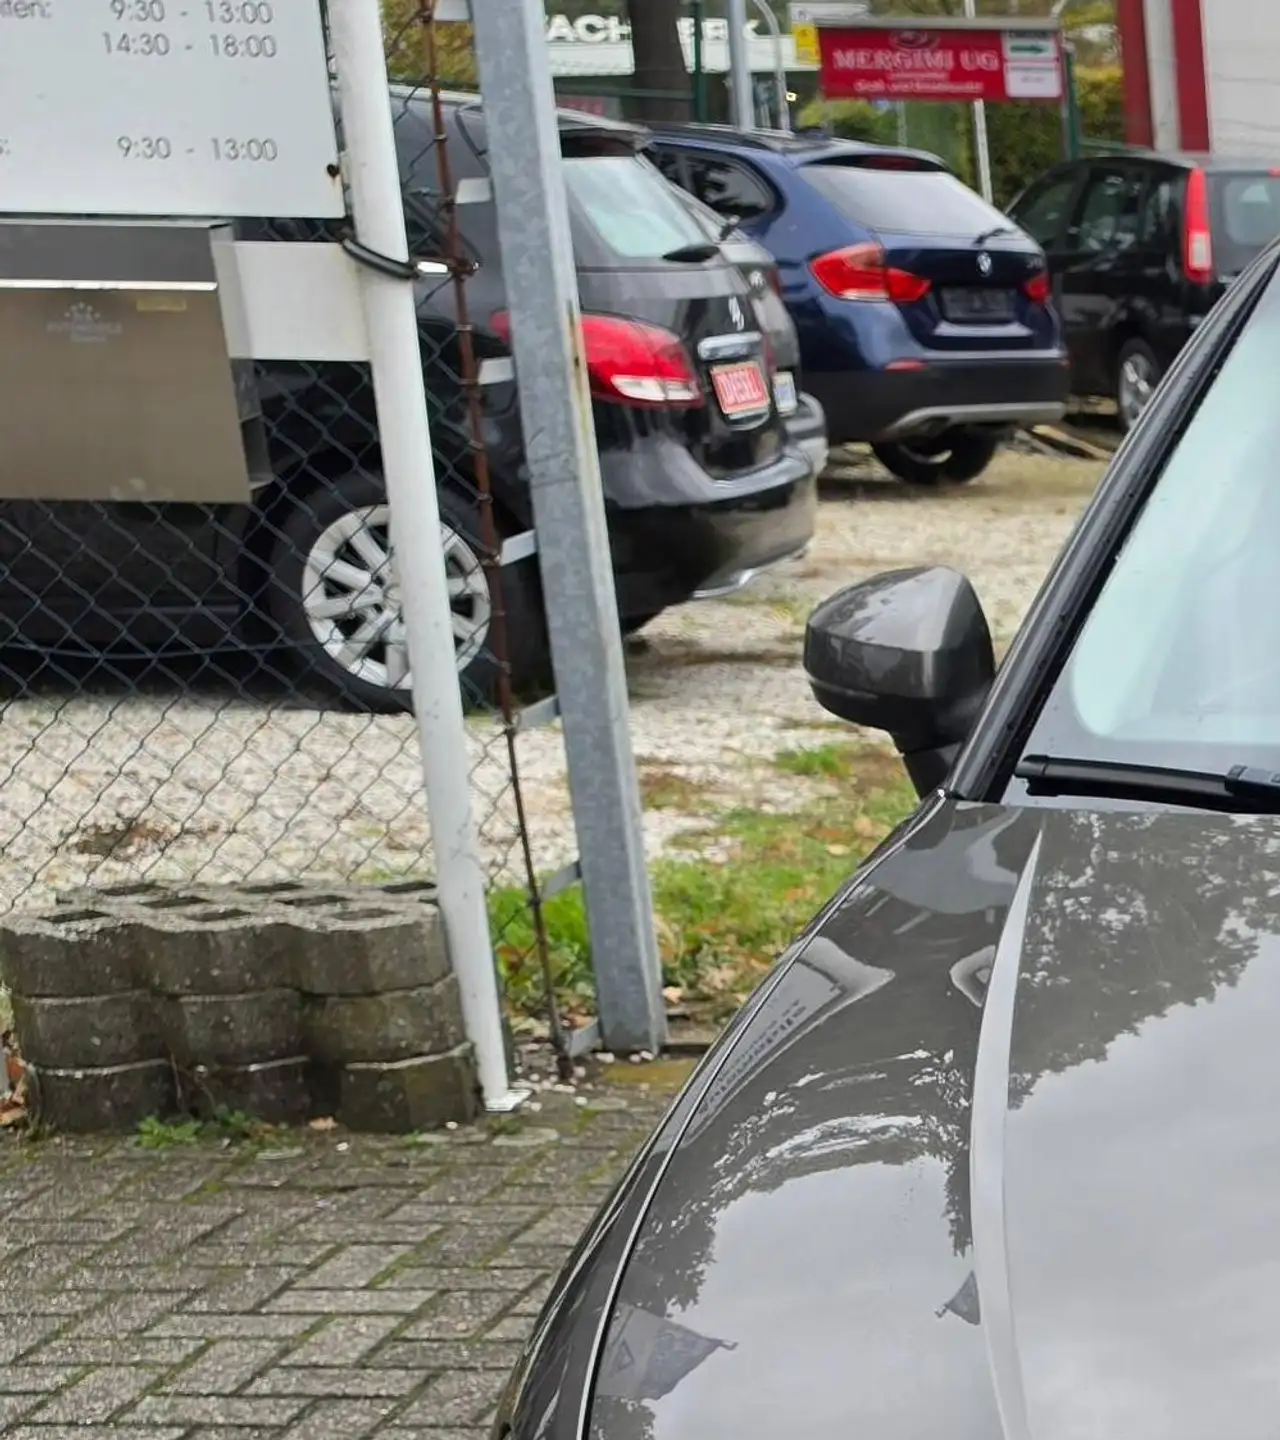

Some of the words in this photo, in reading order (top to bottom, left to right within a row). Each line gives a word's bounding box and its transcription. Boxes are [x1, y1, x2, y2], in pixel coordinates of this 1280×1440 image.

[109, 0, 166, 23] 9:30
[206, 1, 274, 24] 13:00
[102, 31, 170, 56] 14:30
[209, 34, 278, 57] 18:00
[117, 136, 172, 159] 9:30
[211, 138, 279, 162] 13:00
